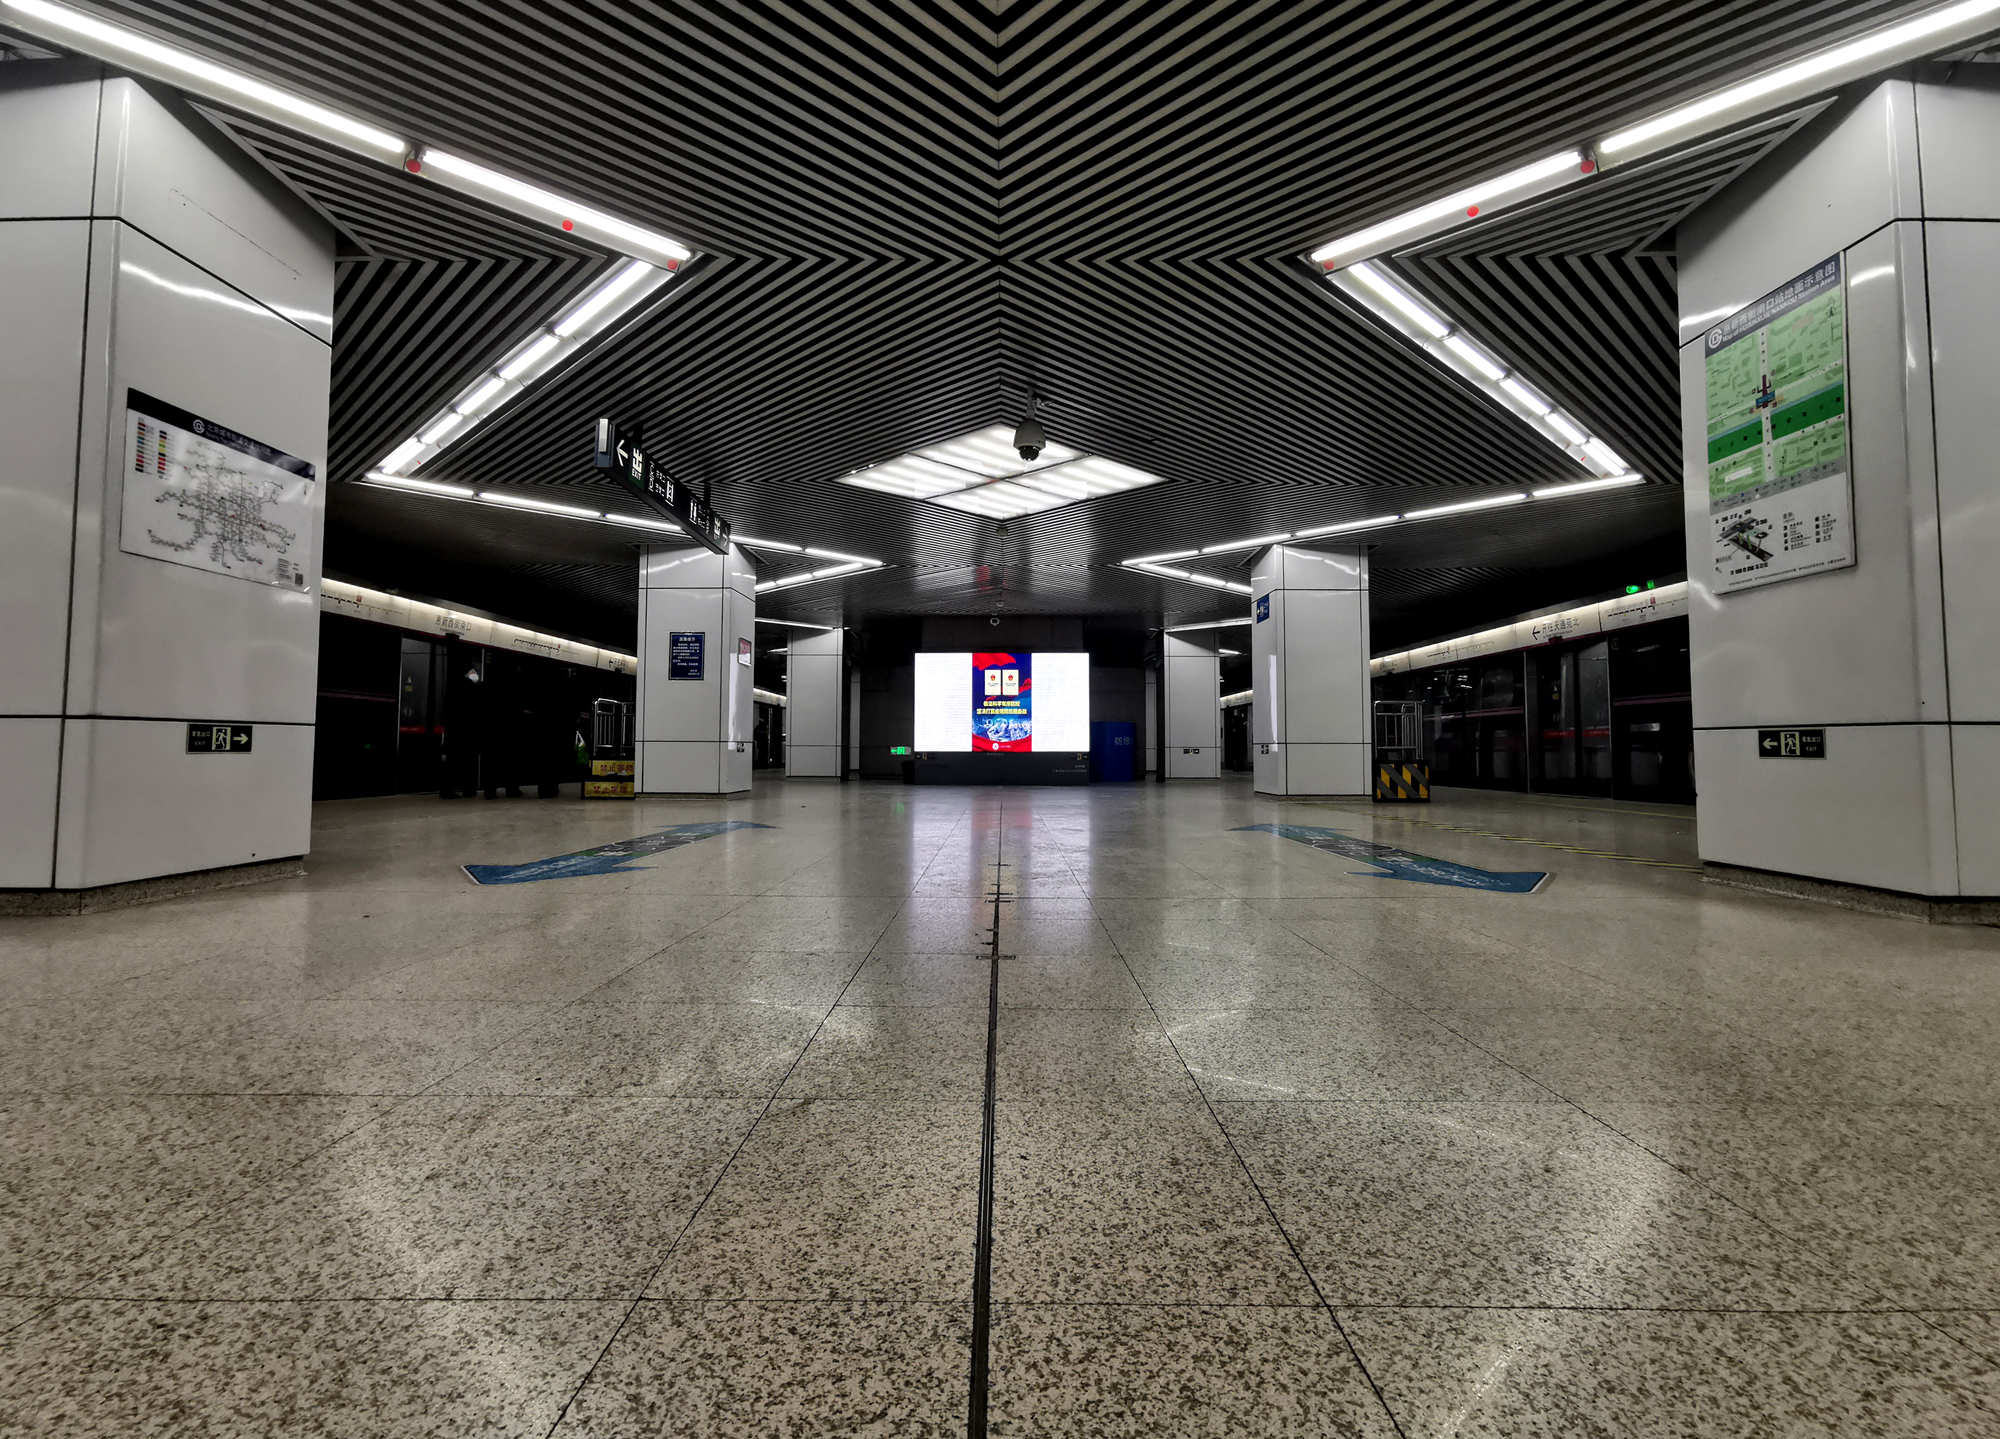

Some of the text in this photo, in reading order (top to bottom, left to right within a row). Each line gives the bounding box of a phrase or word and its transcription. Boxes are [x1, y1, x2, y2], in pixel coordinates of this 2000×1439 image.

[1771, 295, 1798, 314] NANKOU
[1797, 284, 1820, 300] Station
[1819, 275, 1836, 287] Area
[632, 447, 643, 473] 出
[631, 468, 642, 481] EXIT
